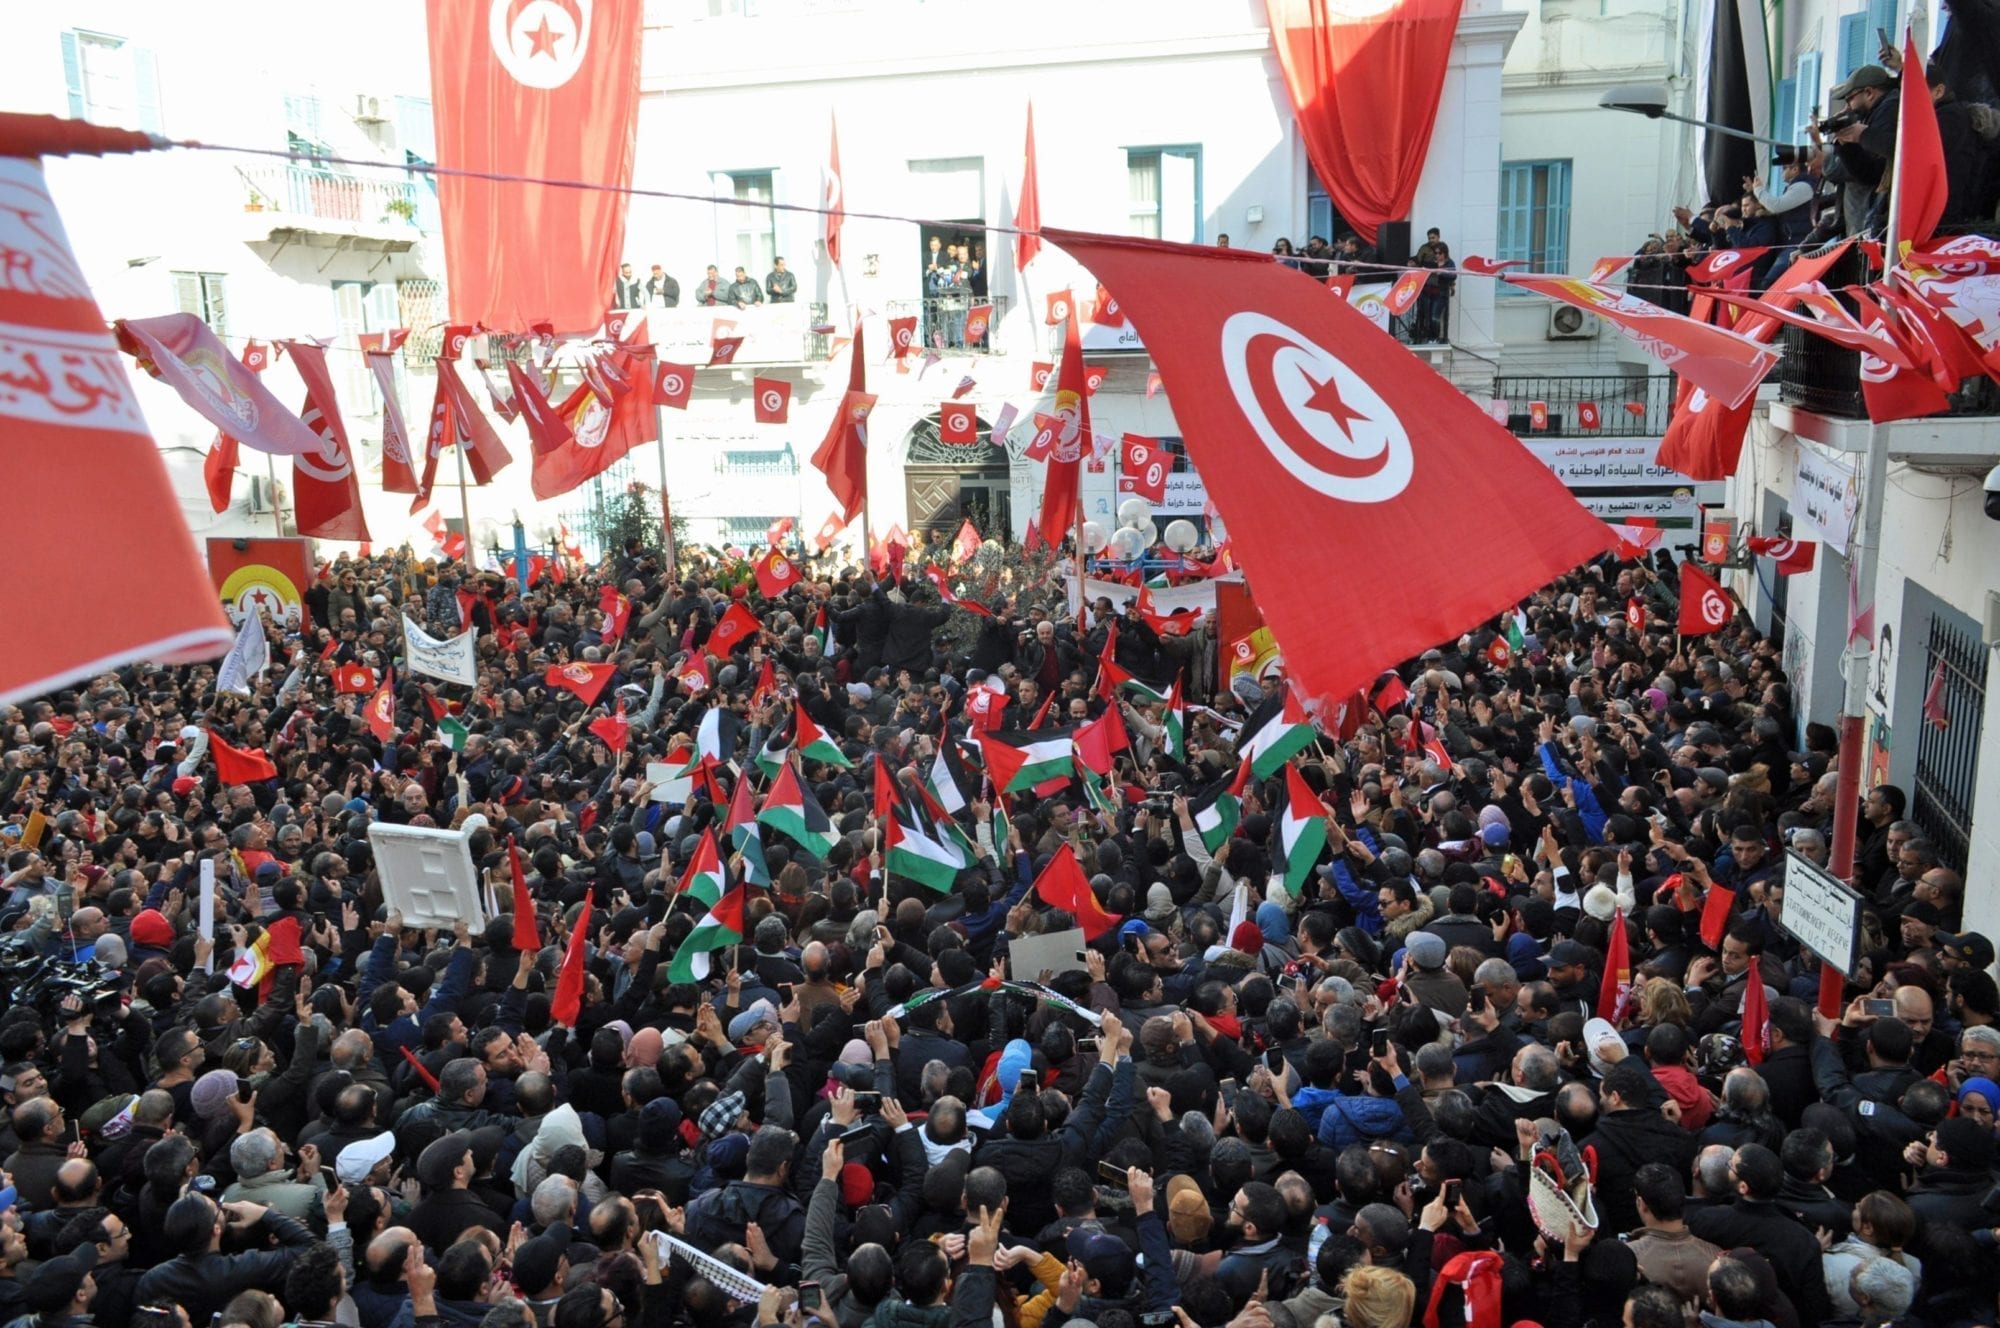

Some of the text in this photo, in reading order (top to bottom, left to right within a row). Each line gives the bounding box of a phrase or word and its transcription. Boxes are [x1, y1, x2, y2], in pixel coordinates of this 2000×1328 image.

[1559, 467, 1565, 477] و
[1569, 463, 1605, 478] الوطنية
[1608, 463, 1643, 478] السيادة
